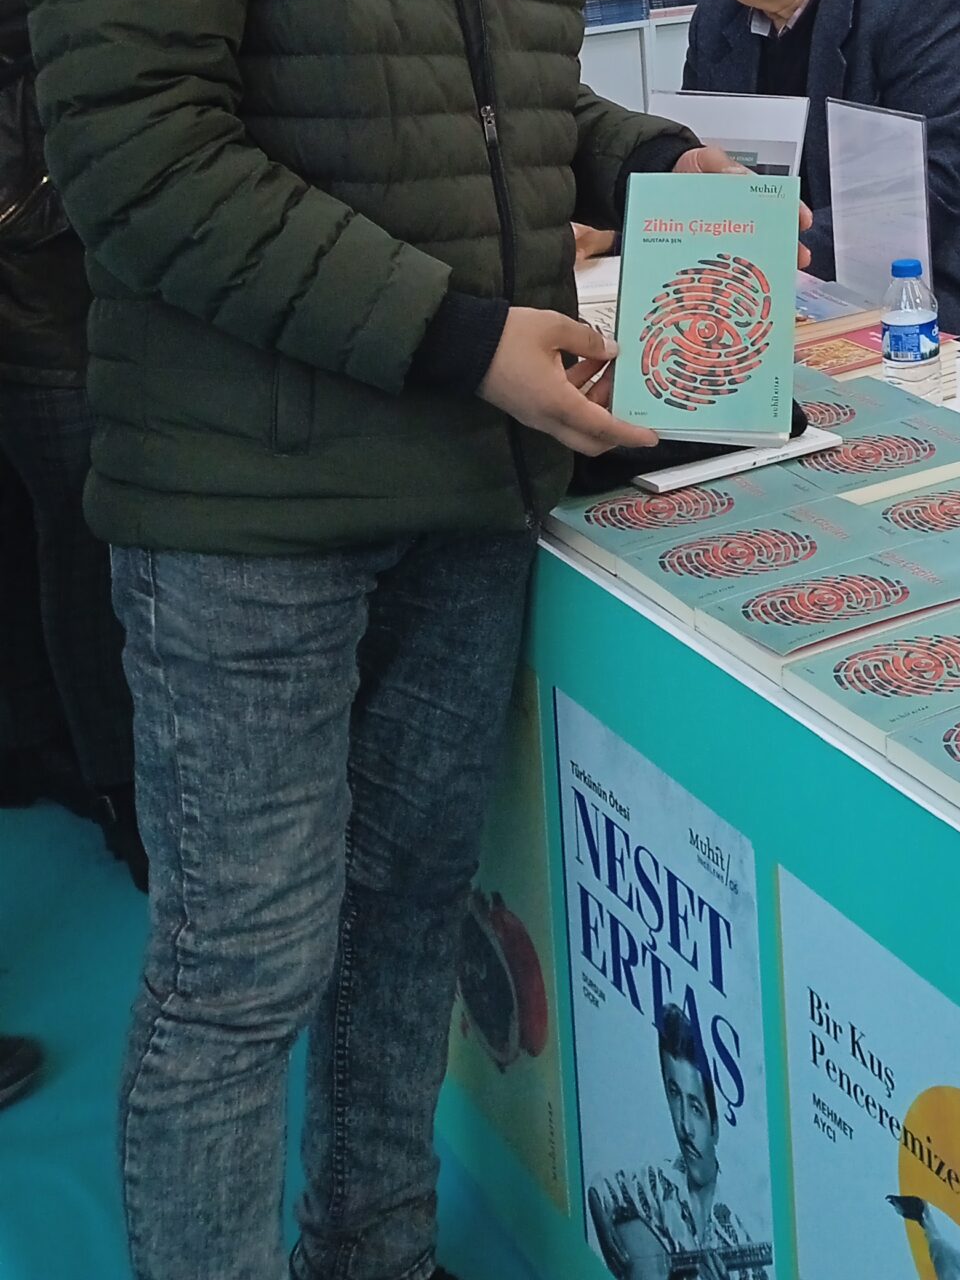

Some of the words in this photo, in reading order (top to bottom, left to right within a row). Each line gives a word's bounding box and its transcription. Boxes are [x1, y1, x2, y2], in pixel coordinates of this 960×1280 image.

[643, 220, 684, 233] Zihin
[689, 220, 756, 236] Çizgileri
[570, 759, 608, 803] Türkünün
[608, 790, 631, 821] Ötesi
[570, 786, 733, 998] NEŞET
[577, 881, 745, 1127] ERTAŞ
[807, 985, 843, 1044] Bir
[849, 1020, 895, 1099] Kuş
[809, 1030, 960, 1195] Penceremize
[812, 1092, 854, 1140] MEHMET
[813, 1113, 837, 1143] AYCI
